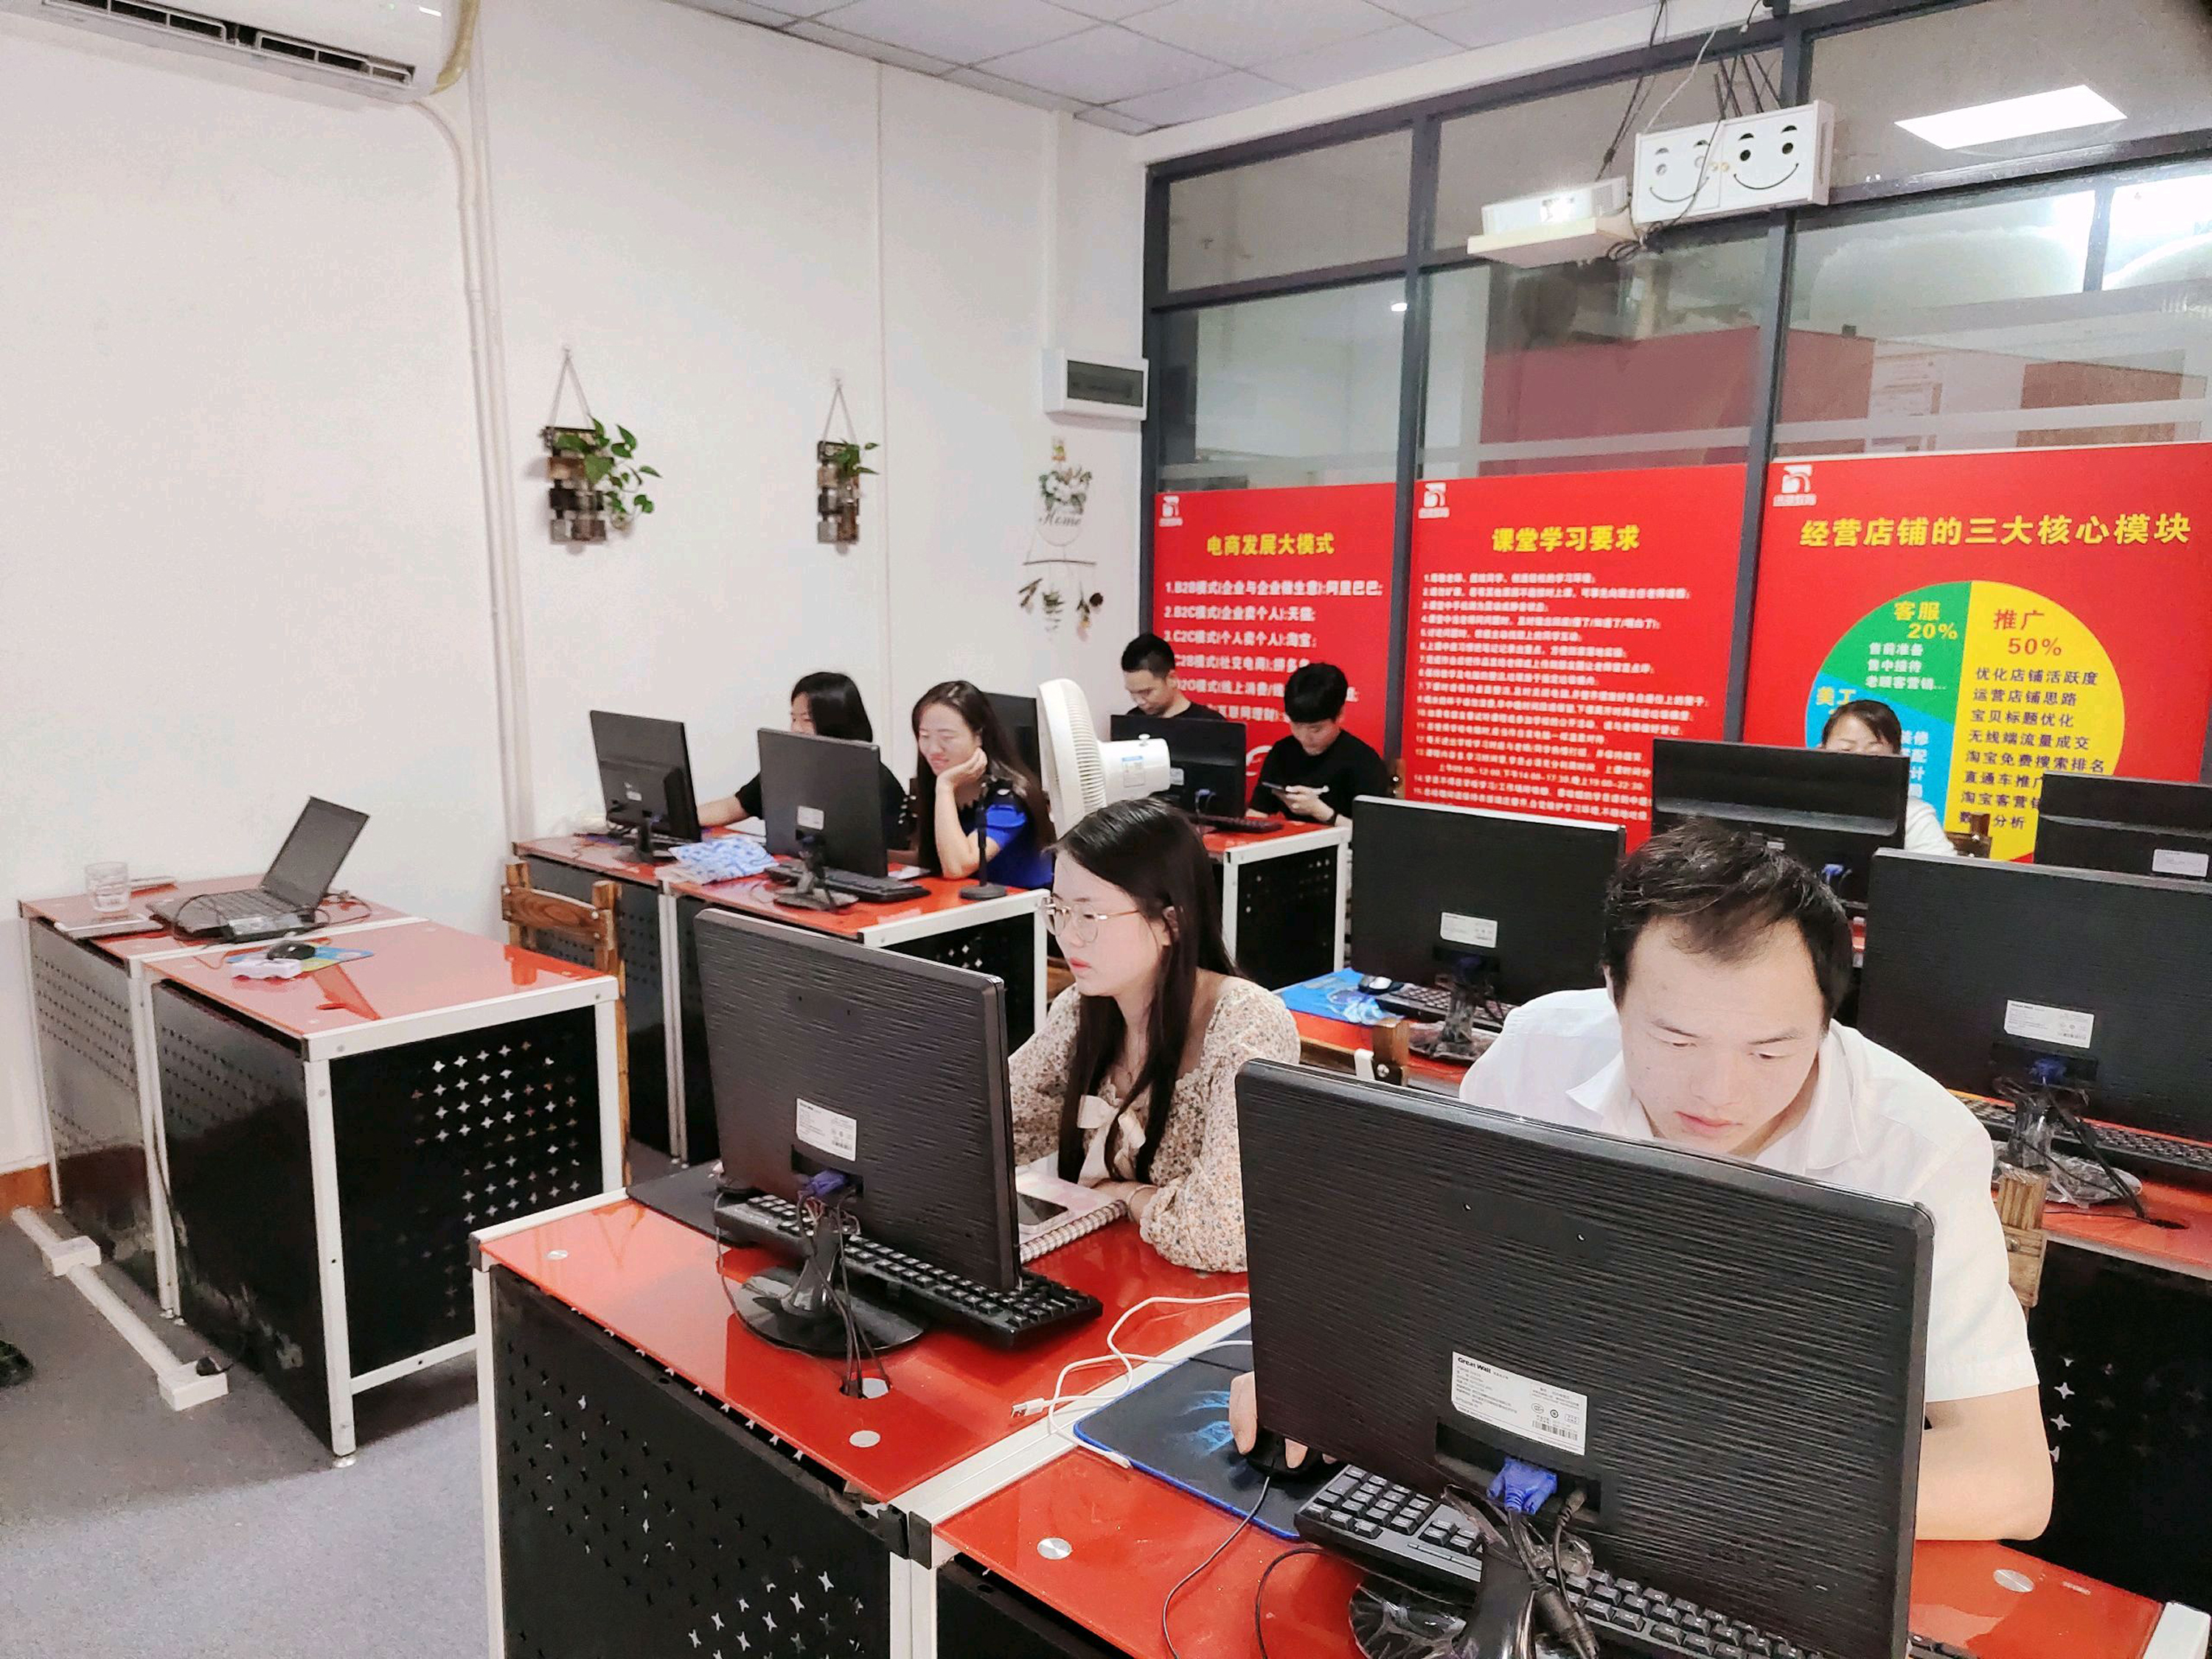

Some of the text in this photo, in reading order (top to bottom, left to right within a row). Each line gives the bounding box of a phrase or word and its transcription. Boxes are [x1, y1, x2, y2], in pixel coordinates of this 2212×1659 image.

[1492, 524, 1640, 552] 课堂学习要求
[1800, 512, 2191, 546] 经营店铺的三大核心模块
[1207, 532, 1335, 556] 电商发展大模式
[1894, 601, 1940, 621] 客服
[1994, 608, 2044, 630] 推广
[1907, 622, 1958, 640] 20%
[2008, 637, 2062, 655] 50%
[1976, 667, 2098, 686] 优化店铺活跃度
[1973, 688, 2077, 706] 运营店铺思路
[1970, 709, 2074, 727] 宝贝标题优化
[1969, 729, 2091, 750] 无线端流量成交
[1966, 750, 2104, 773] 淘宝免费搜索排名
